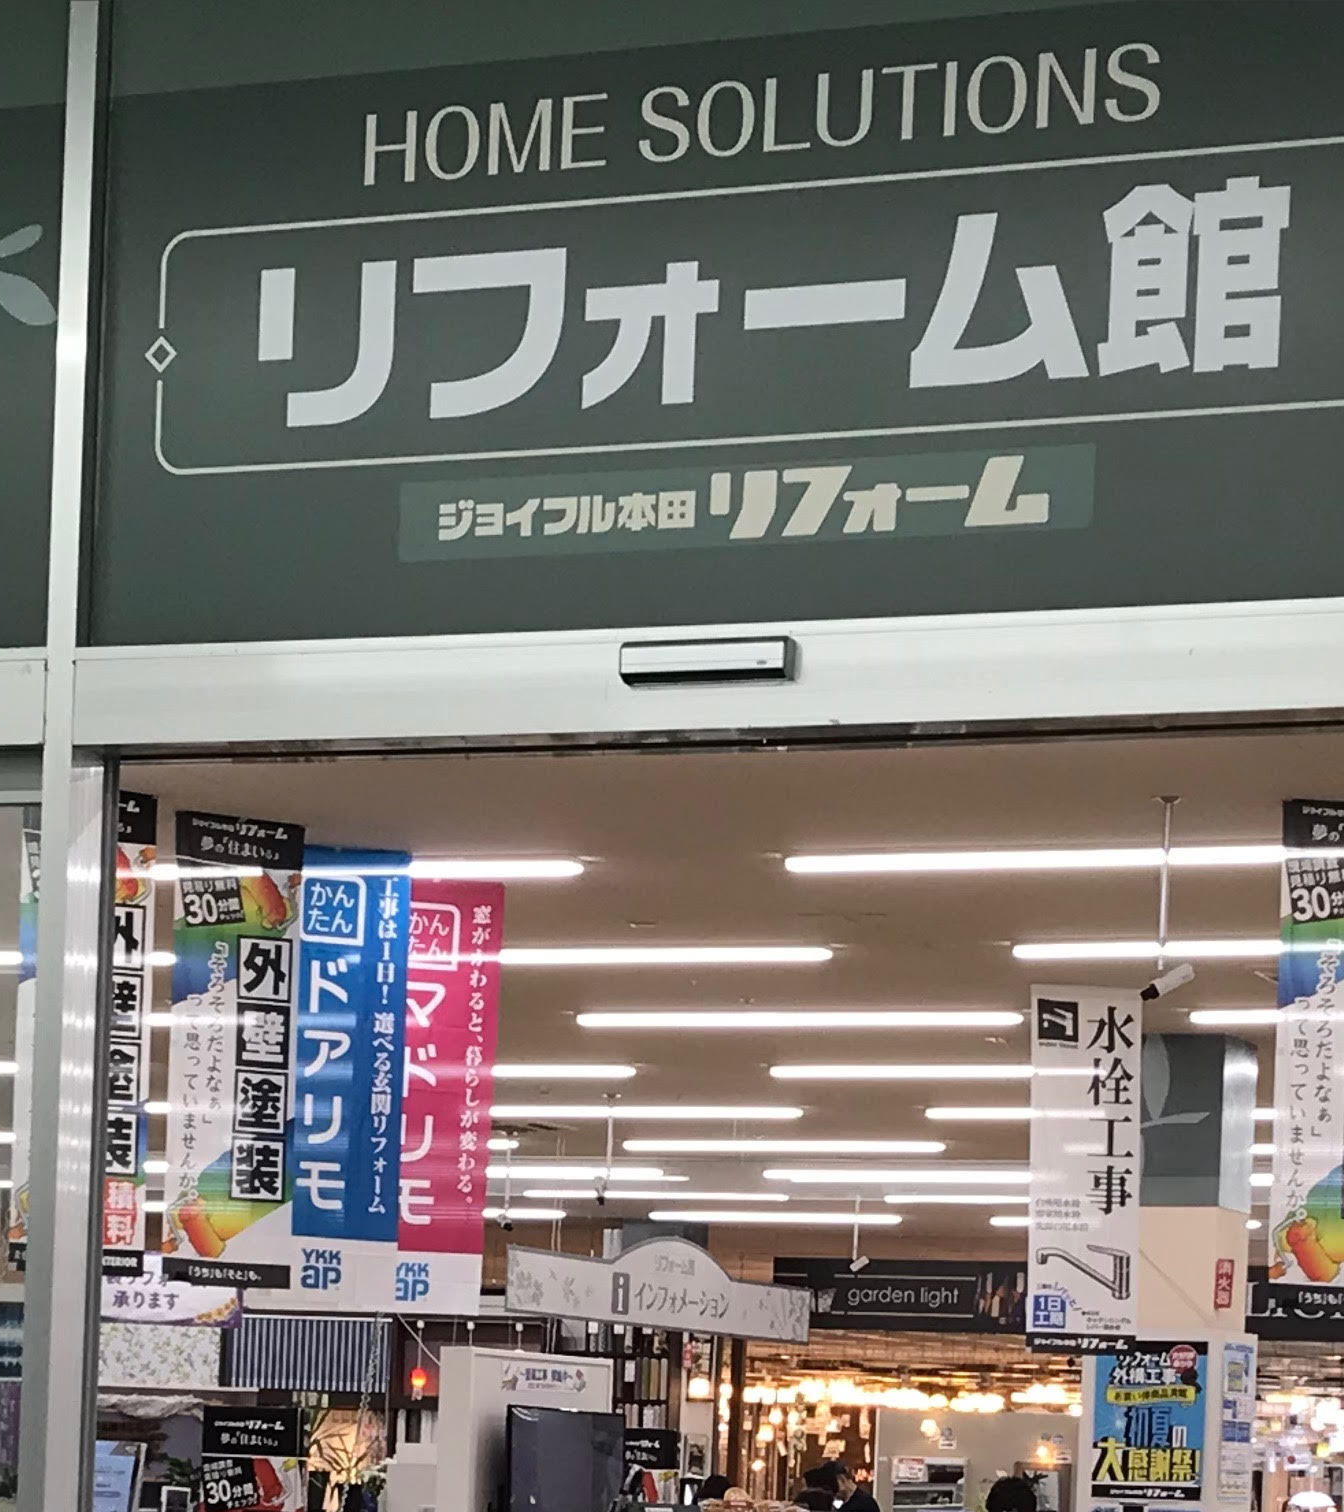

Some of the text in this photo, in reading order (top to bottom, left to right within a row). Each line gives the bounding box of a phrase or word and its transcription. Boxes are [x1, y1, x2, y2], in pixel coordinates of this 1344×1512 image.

[363, 42, 1162, 187] HOME SOLUTIONS
[257, 177, 1291, 428] リフォーム館
[437, 454, 1051, 542] ジョイフル本田 リフォーム
[307, 907, 353, 935] たん
[310, 881, 355, 909] かん
[235, 941, 288, 1197] 外壁塗装
[295, 956, 352, 1211] ドアリモ
[398, 980, 447, 1225] マドリモ
[1085, 1005, 1135, 1216] 水栓工事
[301, 1247, 342, 1267] YKK
[112, 1290, 180, 1310] 承ります
[633, 1281, 731, 1320] インフォメーション
[847, 1285, 960, 1309] garden light
[1096, 1437, 1201, 1482] 大感謝祭!
